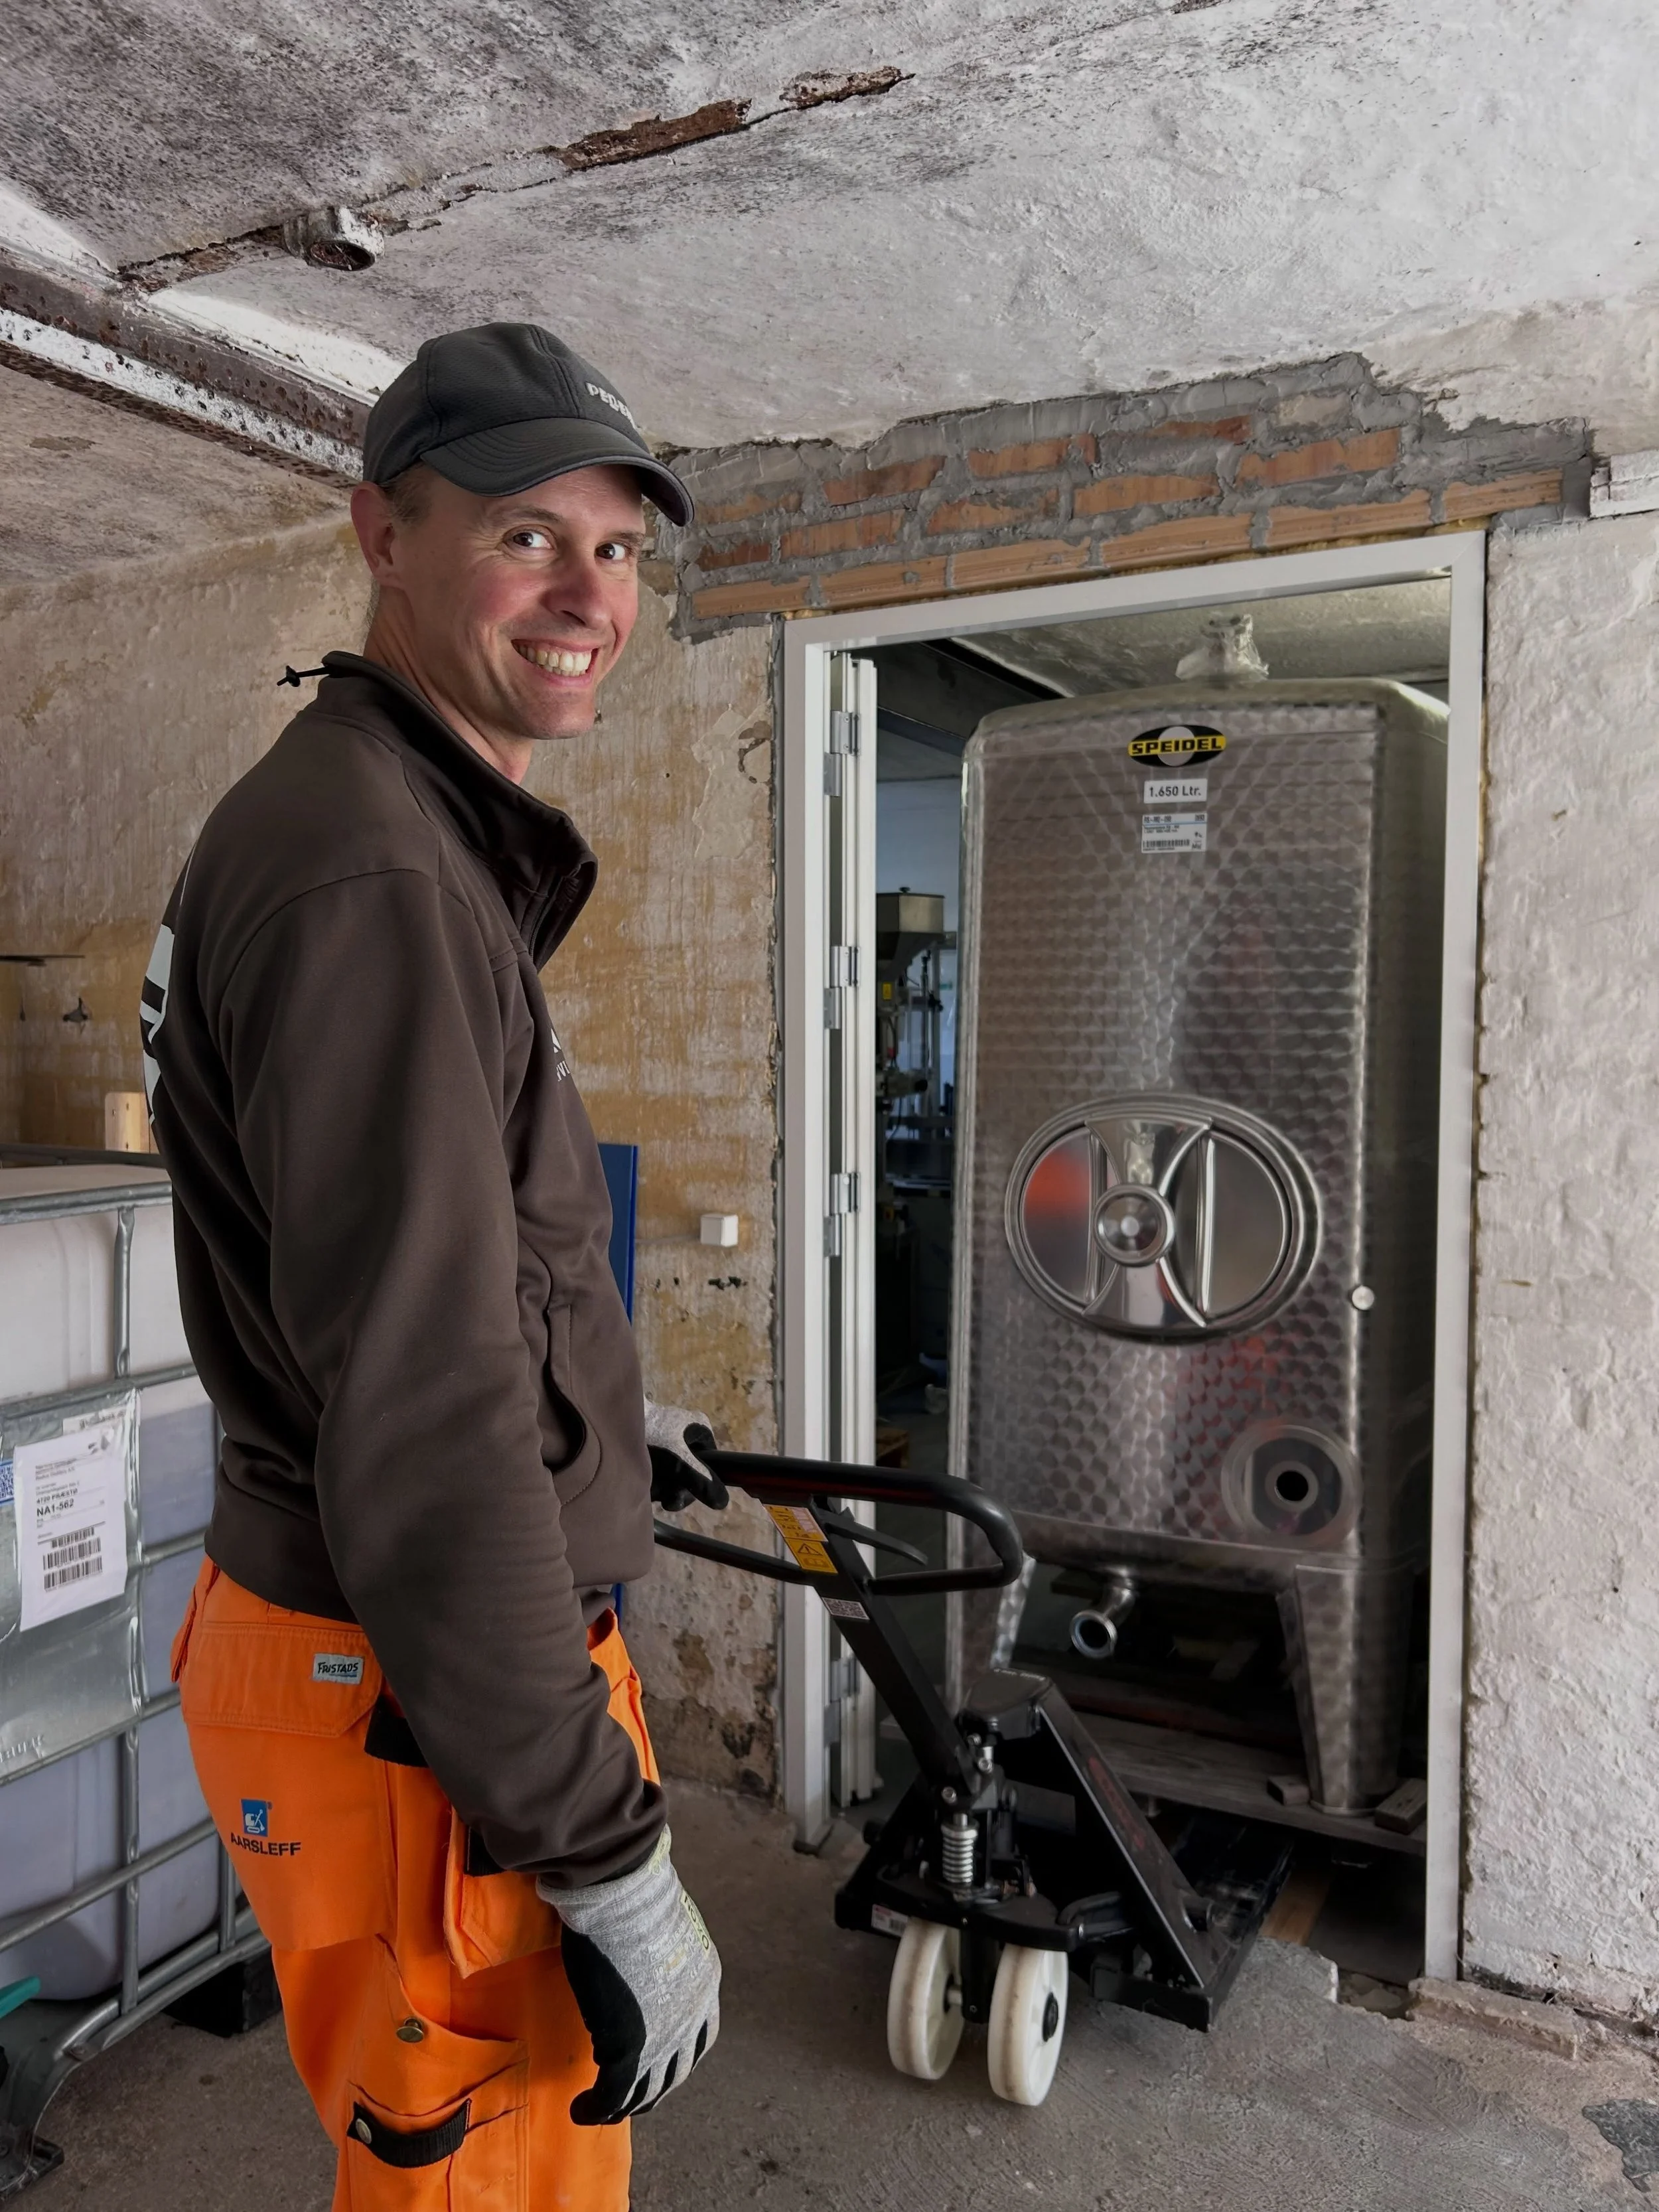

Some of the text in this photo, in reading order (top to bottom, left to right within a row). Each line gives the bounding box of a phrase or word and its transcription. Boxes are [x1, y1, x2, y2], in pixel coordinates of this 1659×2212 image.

[1131, 737, 1222, 755] SPEIDEL
[1149, 786, 1202, 798] 1.650 Ltr.
[37, 1498, 74, 1516] NA1-562
[318, 1662, 359, 1674] FRISTADS
[231, 1832, 301, 1856] AARSLEFF
